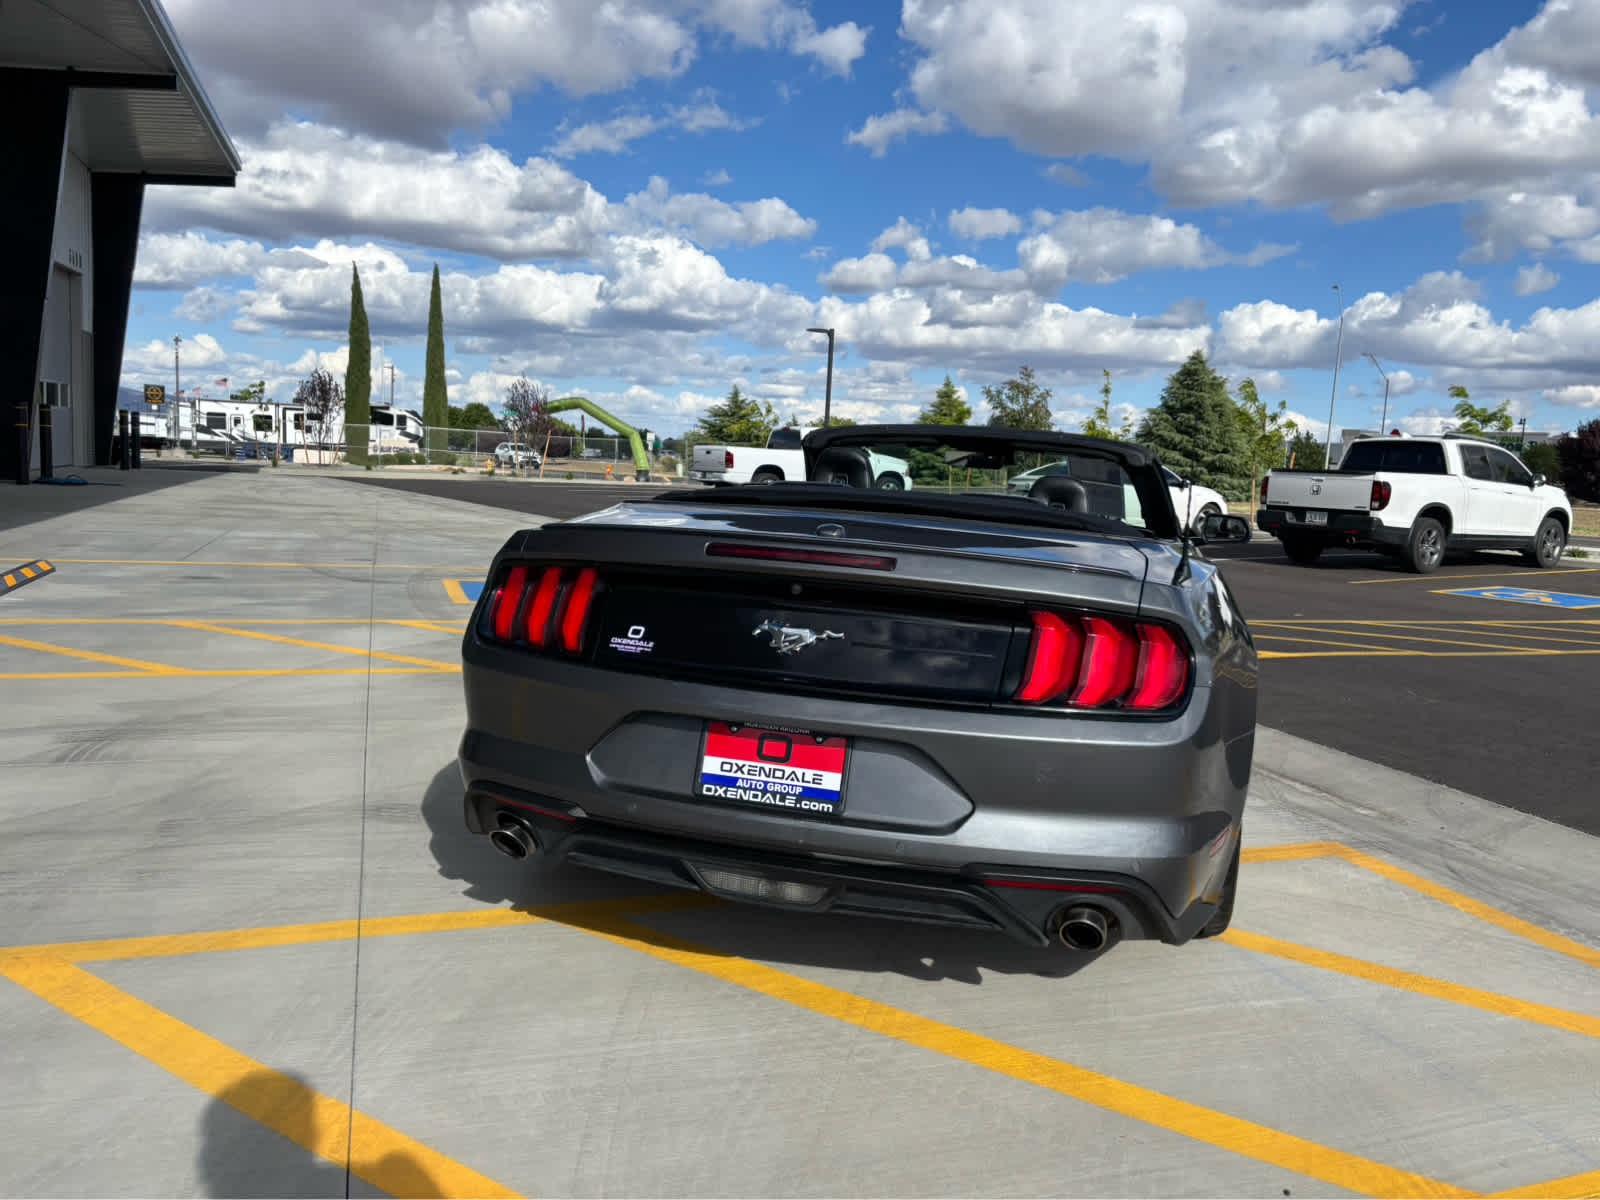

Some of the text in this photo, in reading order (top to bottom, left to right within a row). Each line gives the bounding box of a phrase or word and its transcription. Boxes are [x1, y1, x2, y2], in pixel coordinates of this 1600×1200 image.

[610, 637, 654, 647] OXENDALE
[720, 761, 824, 785] OXENDALE
[736, 778, 803, 795] AUTO GROUP
[702, 784, 833, 813] OXENDALE.com
